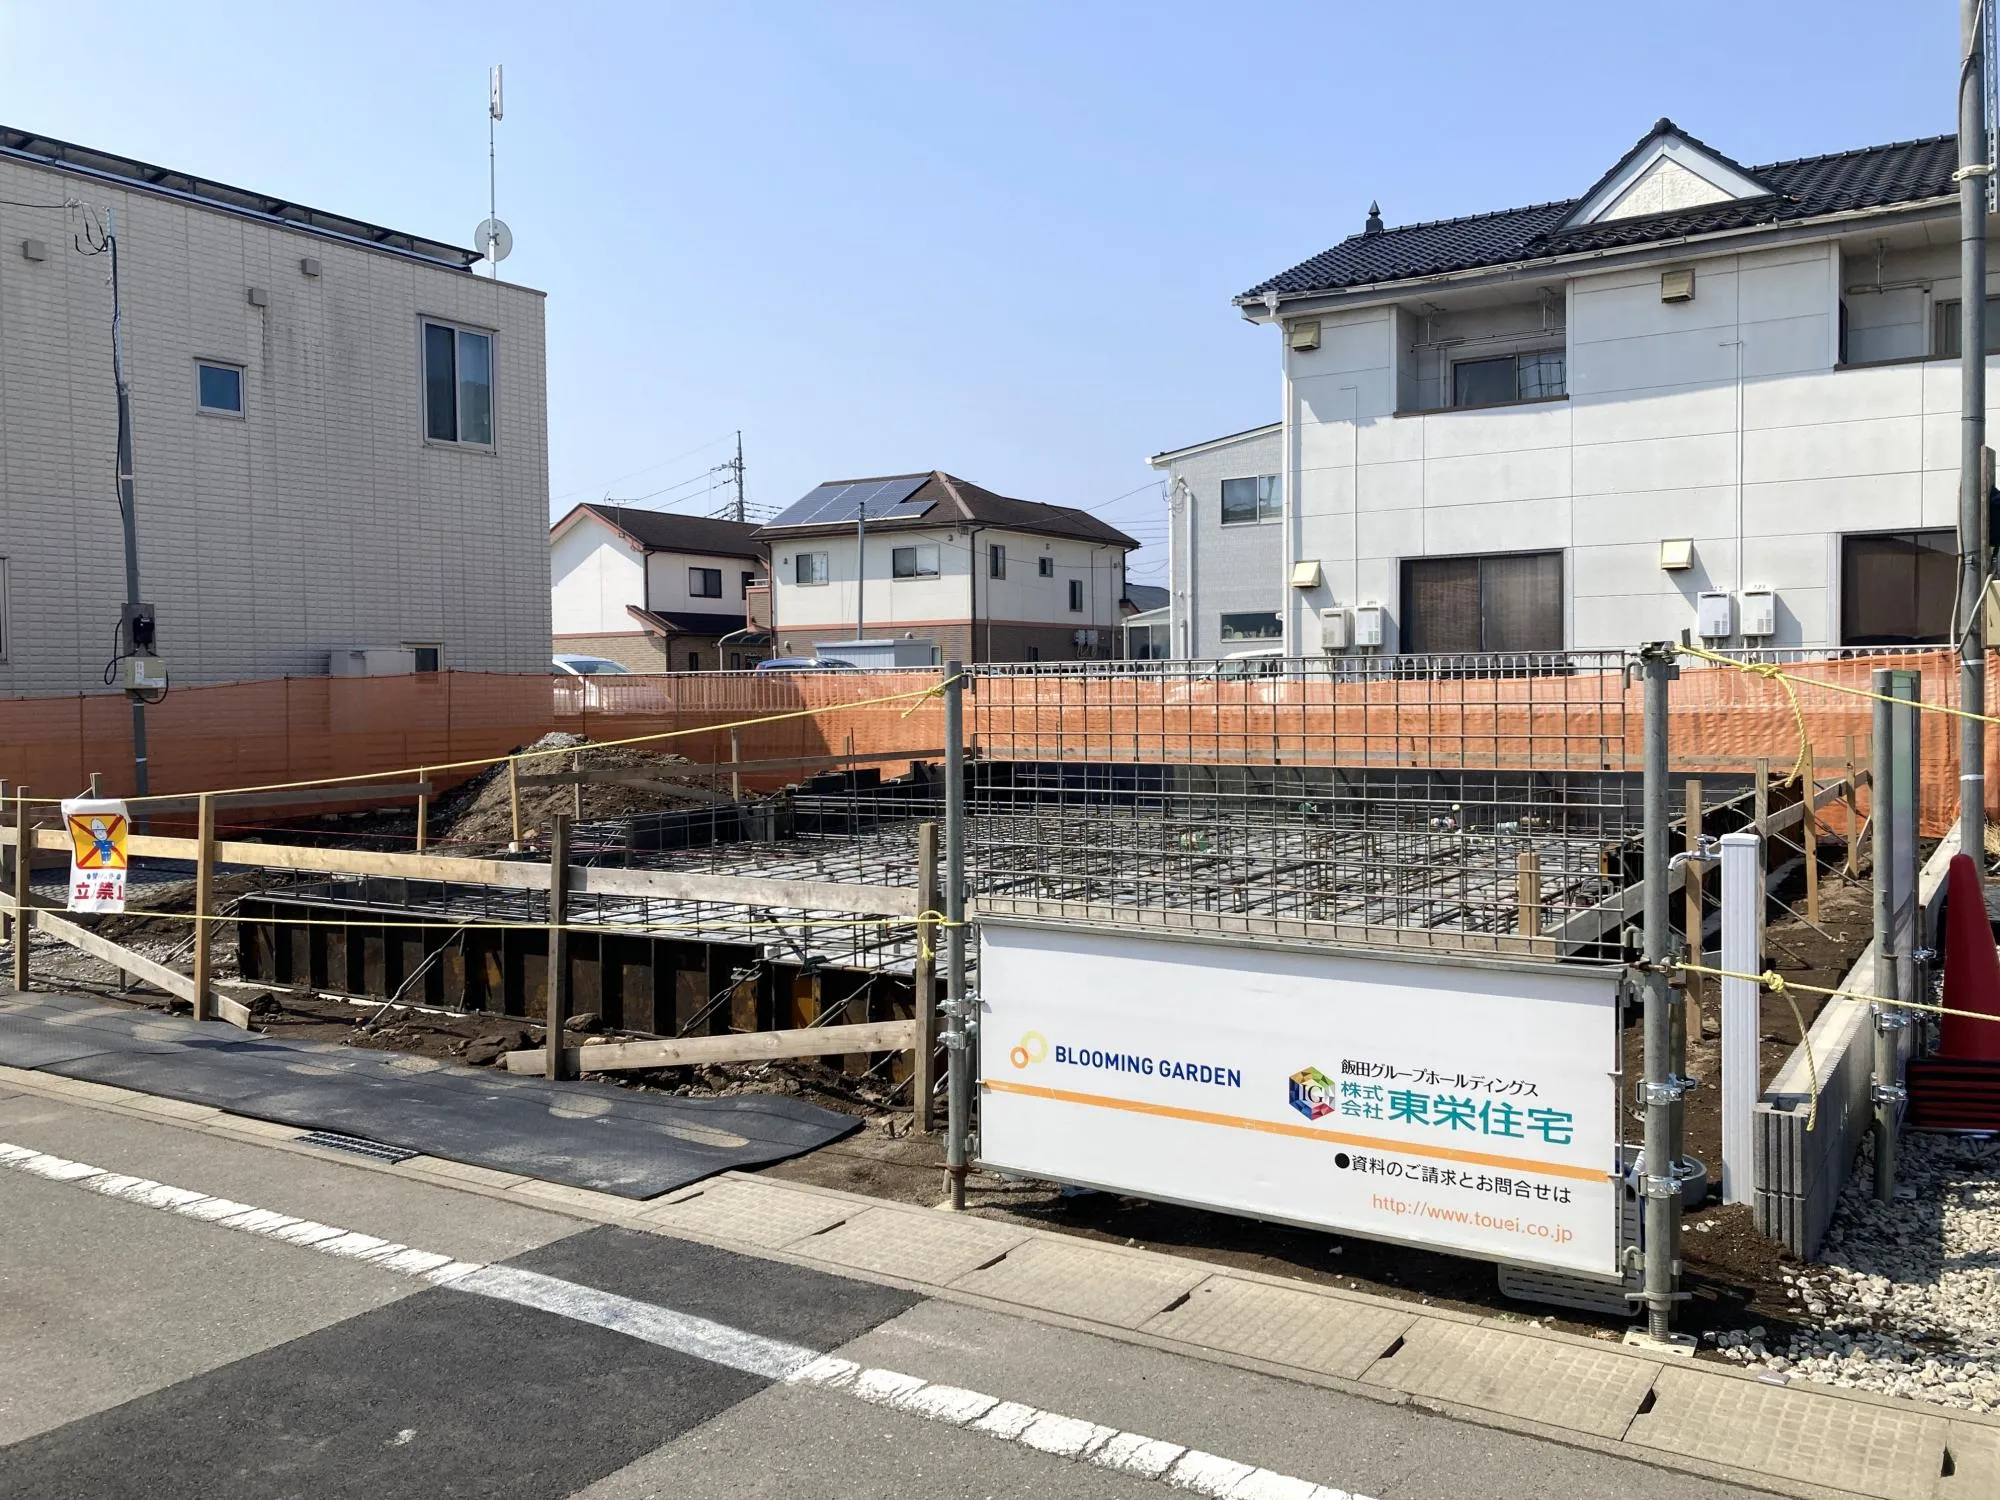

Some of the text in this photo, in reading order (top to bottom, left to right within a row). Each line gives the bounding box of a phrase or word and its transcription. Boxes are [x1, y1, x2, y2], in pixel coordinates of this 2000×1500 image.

[1055, 1045, 1241, 1088] BLOOMING GARDEN
[1340, 1059, 1539, 1097] 飯田グループホールディングス
[1387, 1089, 1574, 1145] 東栄住宅
[1372, 1193, 1573, 1244] http://www.touei.co.jp
